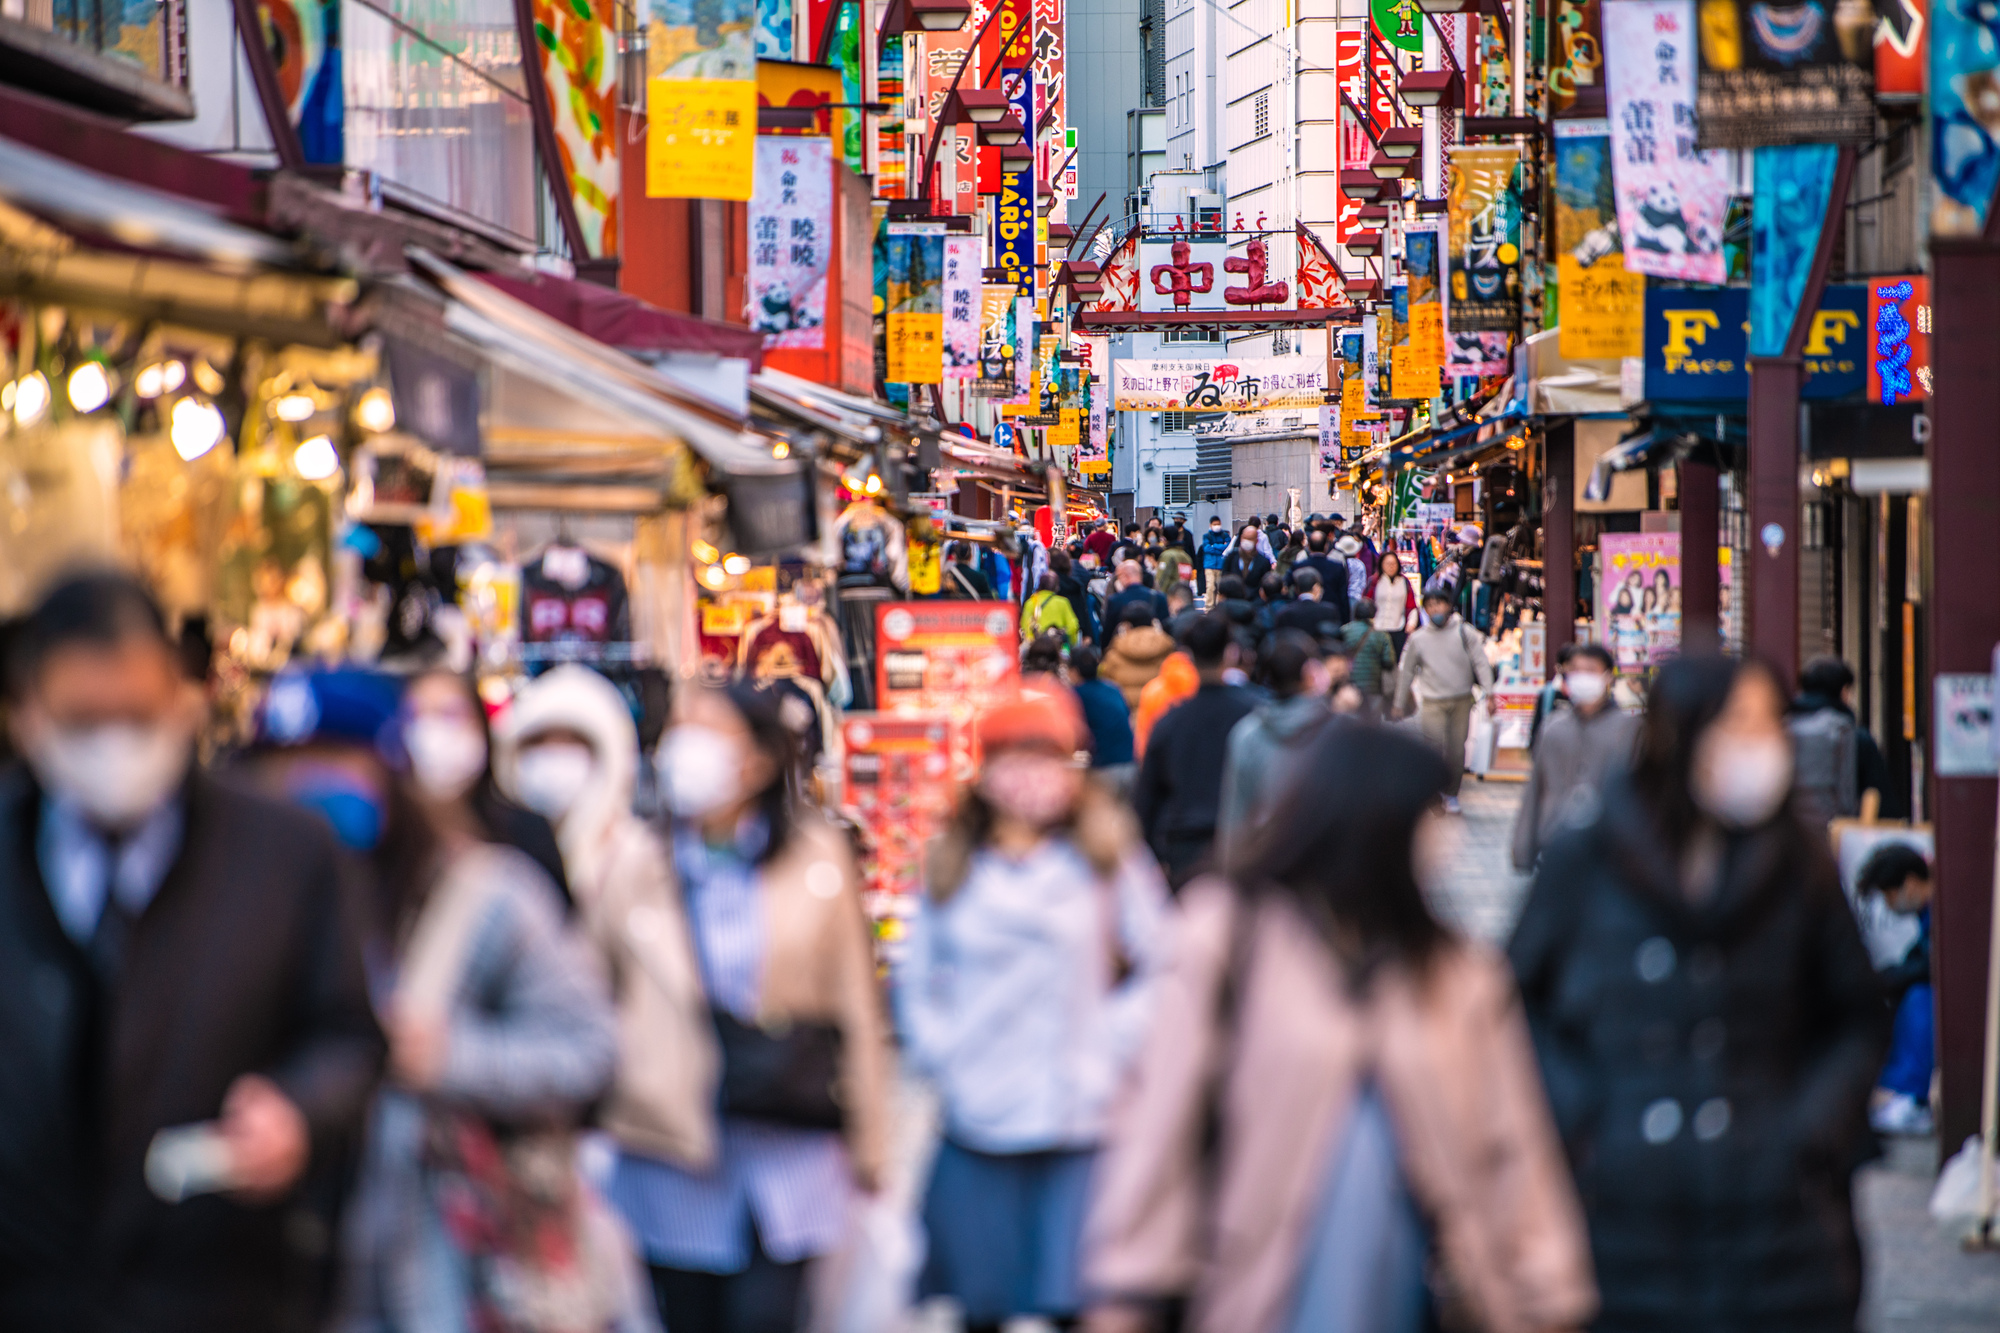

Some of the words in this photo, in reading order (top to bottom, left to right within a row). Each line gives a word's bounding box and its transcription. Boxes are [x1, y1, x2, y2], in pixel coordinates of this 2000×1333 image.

[1665, 353, 1734, 374] Face
[1804, 359, 1855, 374] ace
[1122, 376, 1180, 392] 亥の日は上野で
[1262, 373, 1322, 390] お得とご利益を
